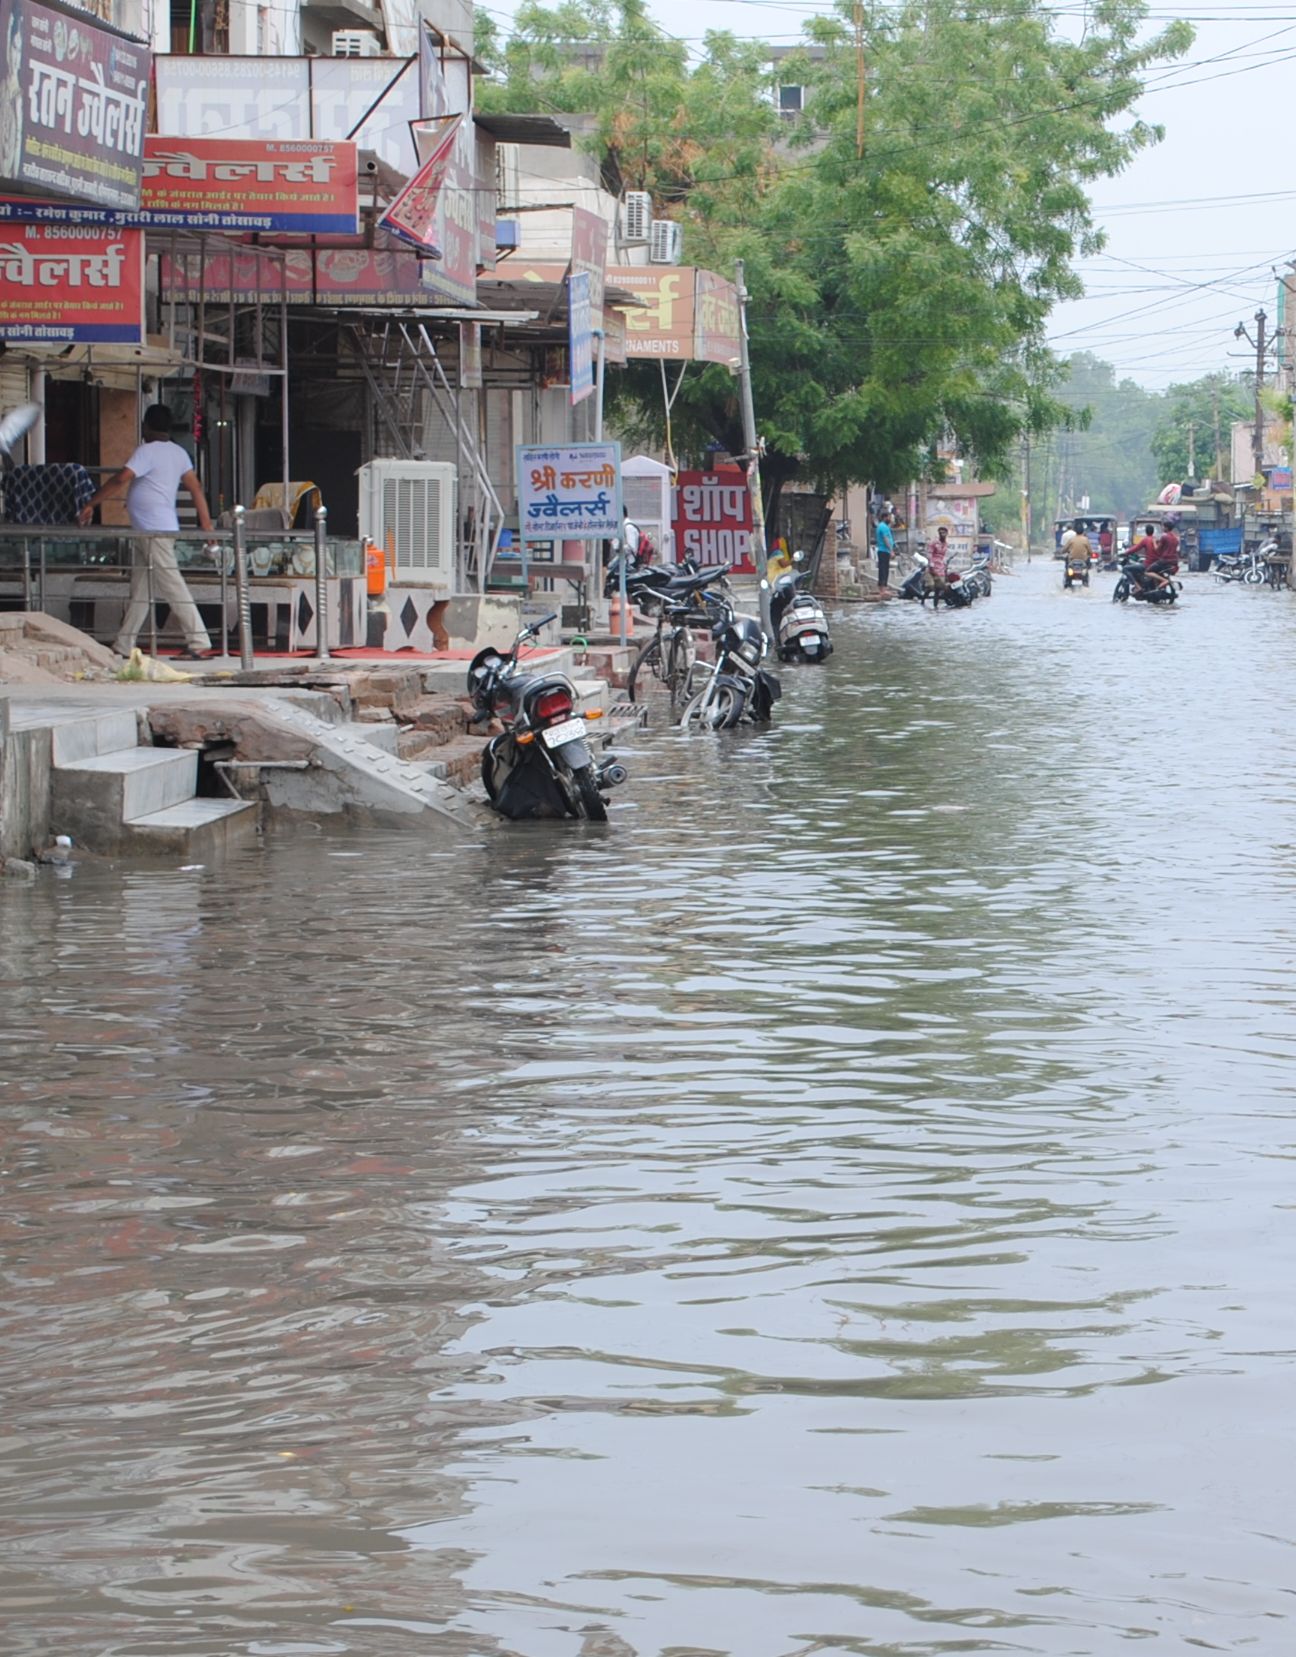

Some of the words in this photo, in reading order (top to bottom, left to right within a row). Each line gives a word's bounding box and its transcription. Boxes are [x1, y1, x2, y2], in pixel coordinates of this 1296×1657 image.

[28, 58, 76, 135] रतन
[35, 205, 67, 219] रमेश
[69, 209, 107, 223] कुमार
[153, 213, 184, 225] लाल
[186, 211, 219, 227] सोनी
[25, 225, 40, 239] M.
[44, 225, 123, 240] 8560000757
[0, 242, 126, 287] वैलर्स
[625, 339, 679, 354] NAMENTS
[530, 464, 556, 492] श्री
[560, 463, 616, 490] करणी
[527, 491, 611, 518] ज्वैलर्स
[682, 476, 747, 522] शॉप
[683, 528, 750, 565] SHOP
